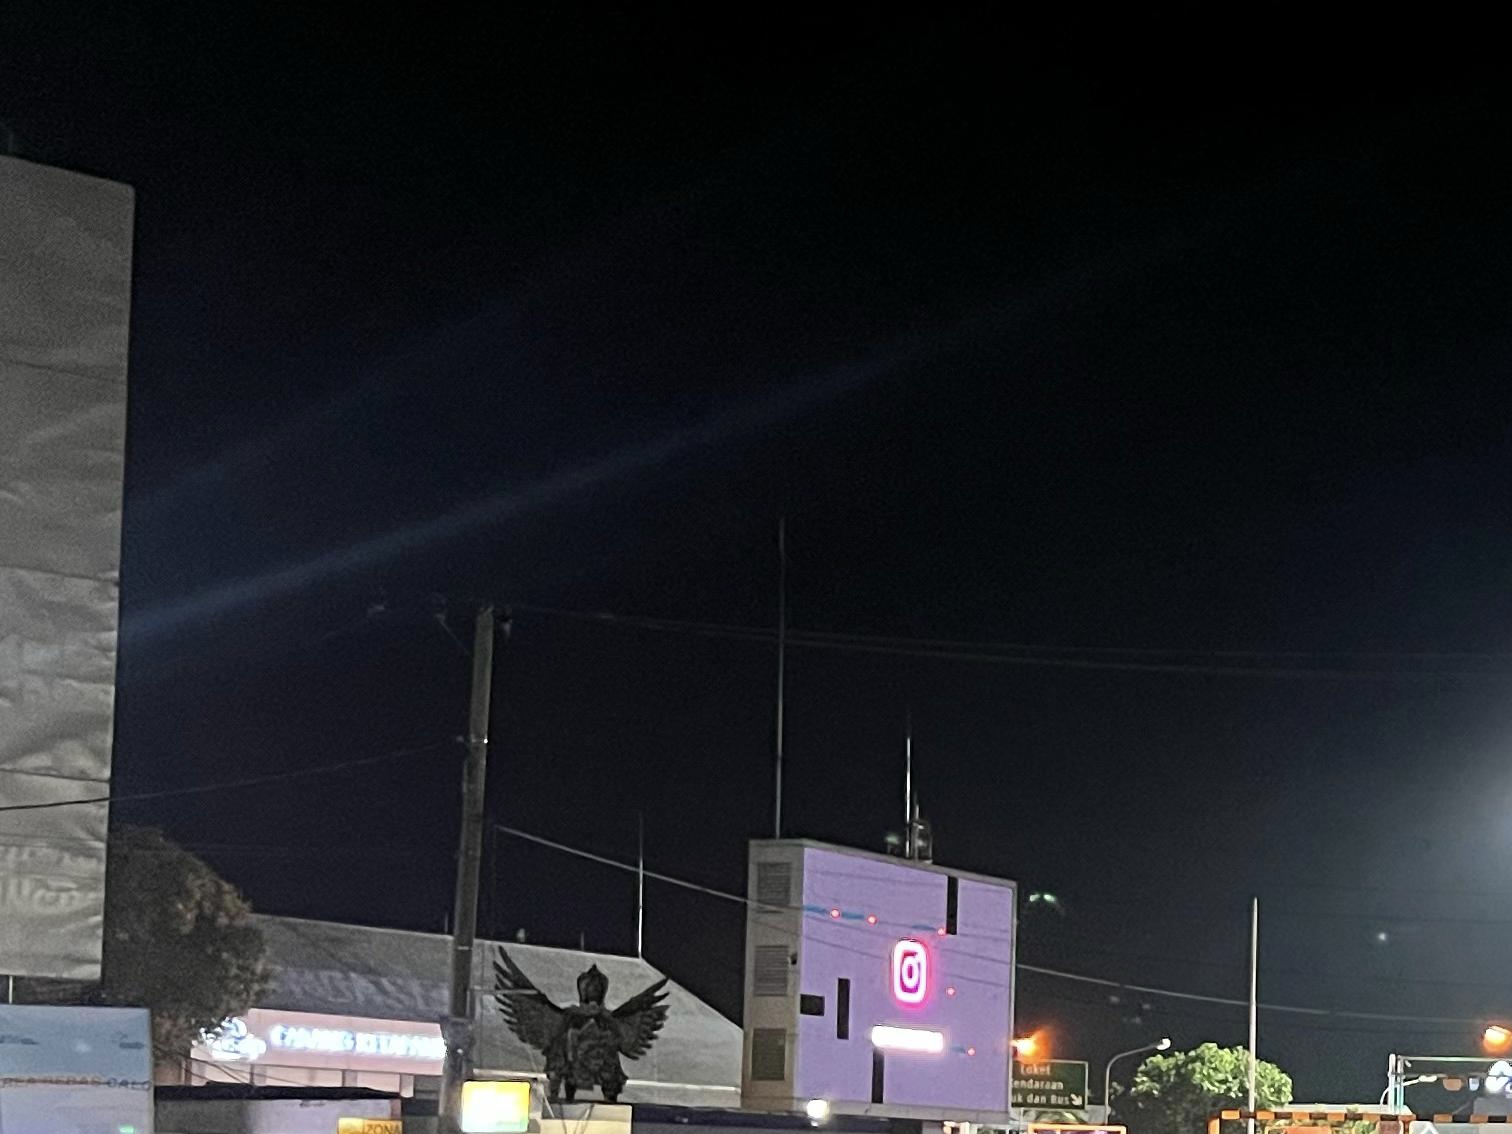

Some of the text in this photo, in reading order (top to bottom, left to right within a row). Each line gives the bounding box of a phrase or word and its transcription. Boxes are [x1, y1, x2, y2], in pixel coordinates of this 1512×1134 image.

[1020, 1062, 1051, 1075] Loket
[1012, 1079, 1064, 1090] endaraan
[1027, 1093, 1047, 1104] dan
[1050, 1094, 1070, 1105] Bus
